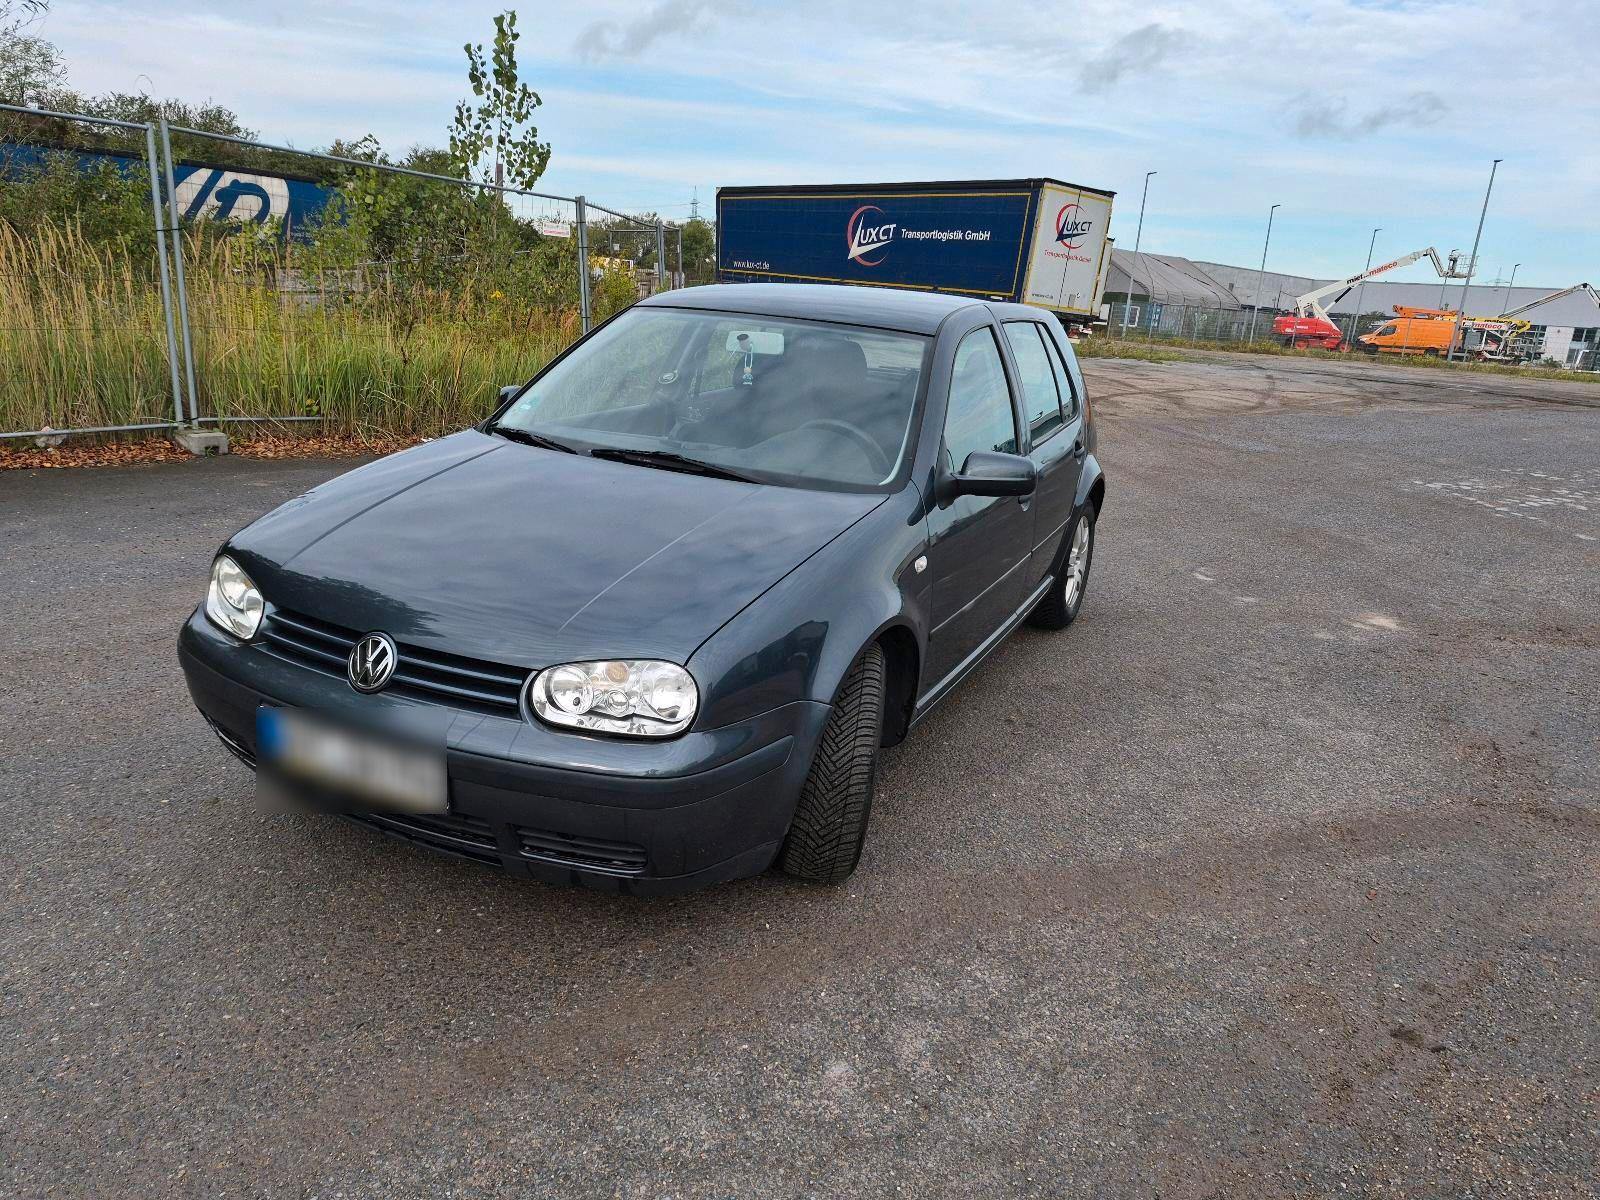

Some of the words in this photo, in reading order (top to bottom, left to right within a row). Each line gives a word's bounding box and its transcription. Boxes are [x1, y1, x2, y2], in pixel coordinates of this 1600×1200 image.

[901, 228, 963, 241] Transportlogistik
[965, 230, 990, 241] GmbH
[733, 260, 770, 270] www.lux-ct.de
